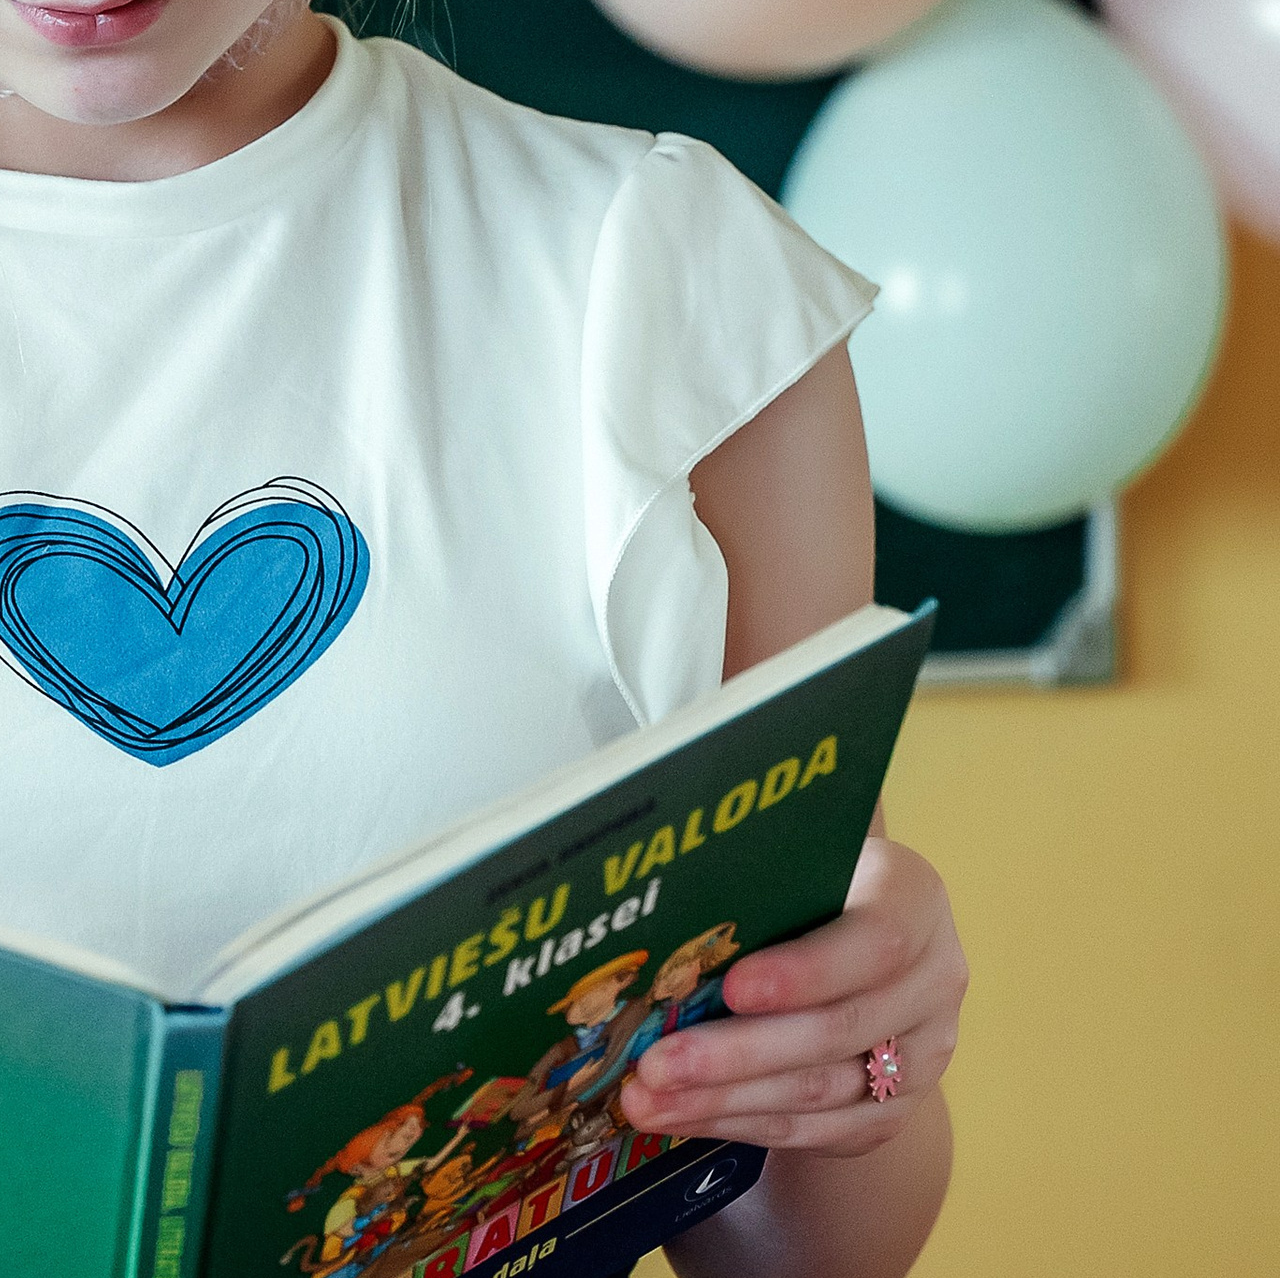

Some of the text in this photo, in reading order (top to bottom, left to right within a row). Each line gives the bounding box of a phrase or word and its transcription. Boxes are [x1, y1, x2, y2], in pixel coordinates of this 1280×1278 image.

[267, 883, 570, 1095] LATVIEŠU
[603, 734, 841, 897] VALODA
[431, 876, 661, 1035] 4. klasei
